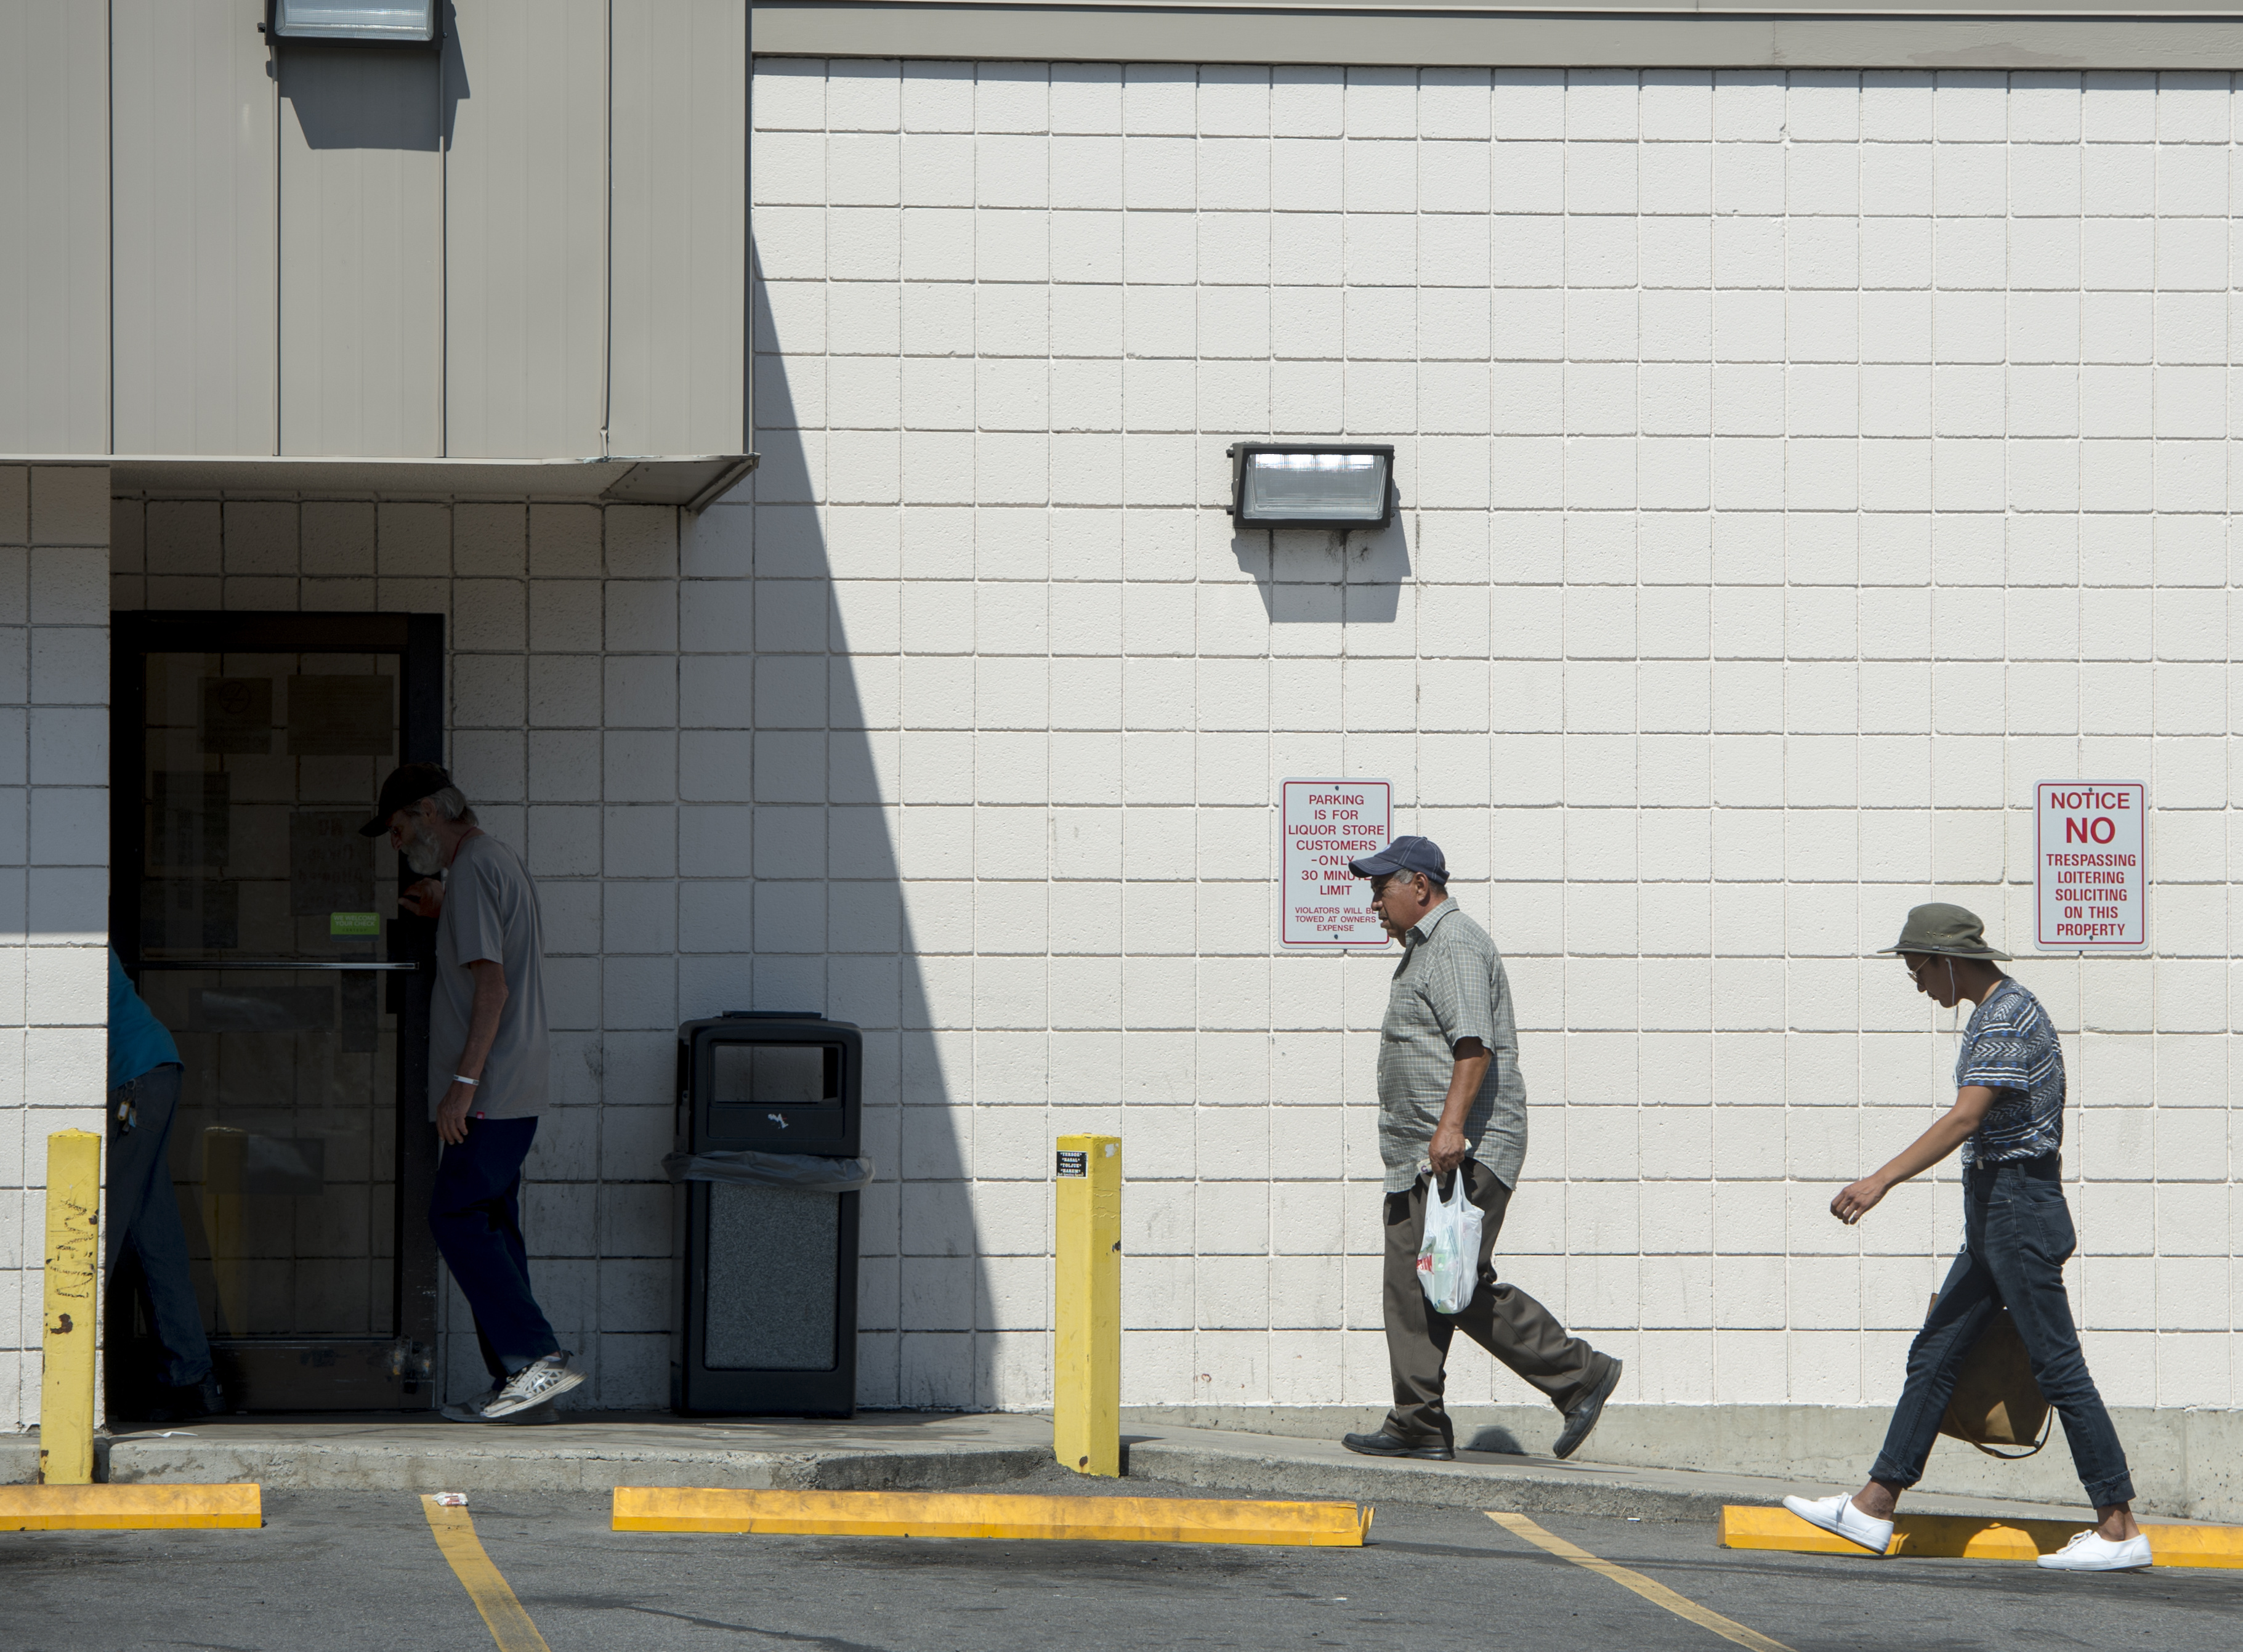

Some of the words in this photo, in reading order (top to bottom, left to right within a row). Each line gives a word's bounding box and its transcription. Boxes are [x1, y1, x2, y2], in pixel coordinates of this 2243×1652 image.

[1309, 795, 1364, 805] PARKING
[2051, 792, 2130, 809] NOTICE
[1314, 810, 1327, 820] IS
[1332, 810, 1359, 820] FOR
[1288, 825, 1336, 835] LIQUOR
[1343, 825, 1384, 835] STORE
[2066, 817, 2116, 844] NO
[1296, 840, 1376, 851] CUSTOMERS
[2046, 854, 2136, 867] TRESPASSING
[1301, 870, 1318, 880] 30
[1324, 870, 1371, 880] MINU
[2057, 871, 2125, 884] LOITERING
[1320, 885, 1352, 895] LIMIT
[2055, 889, 2127, 901] SOLICITING
[2064, 906, 2083, 918] ON
[2088, 906, 2119, 918] THIS
[2056, 923, 2125, 936] PROPERTY
